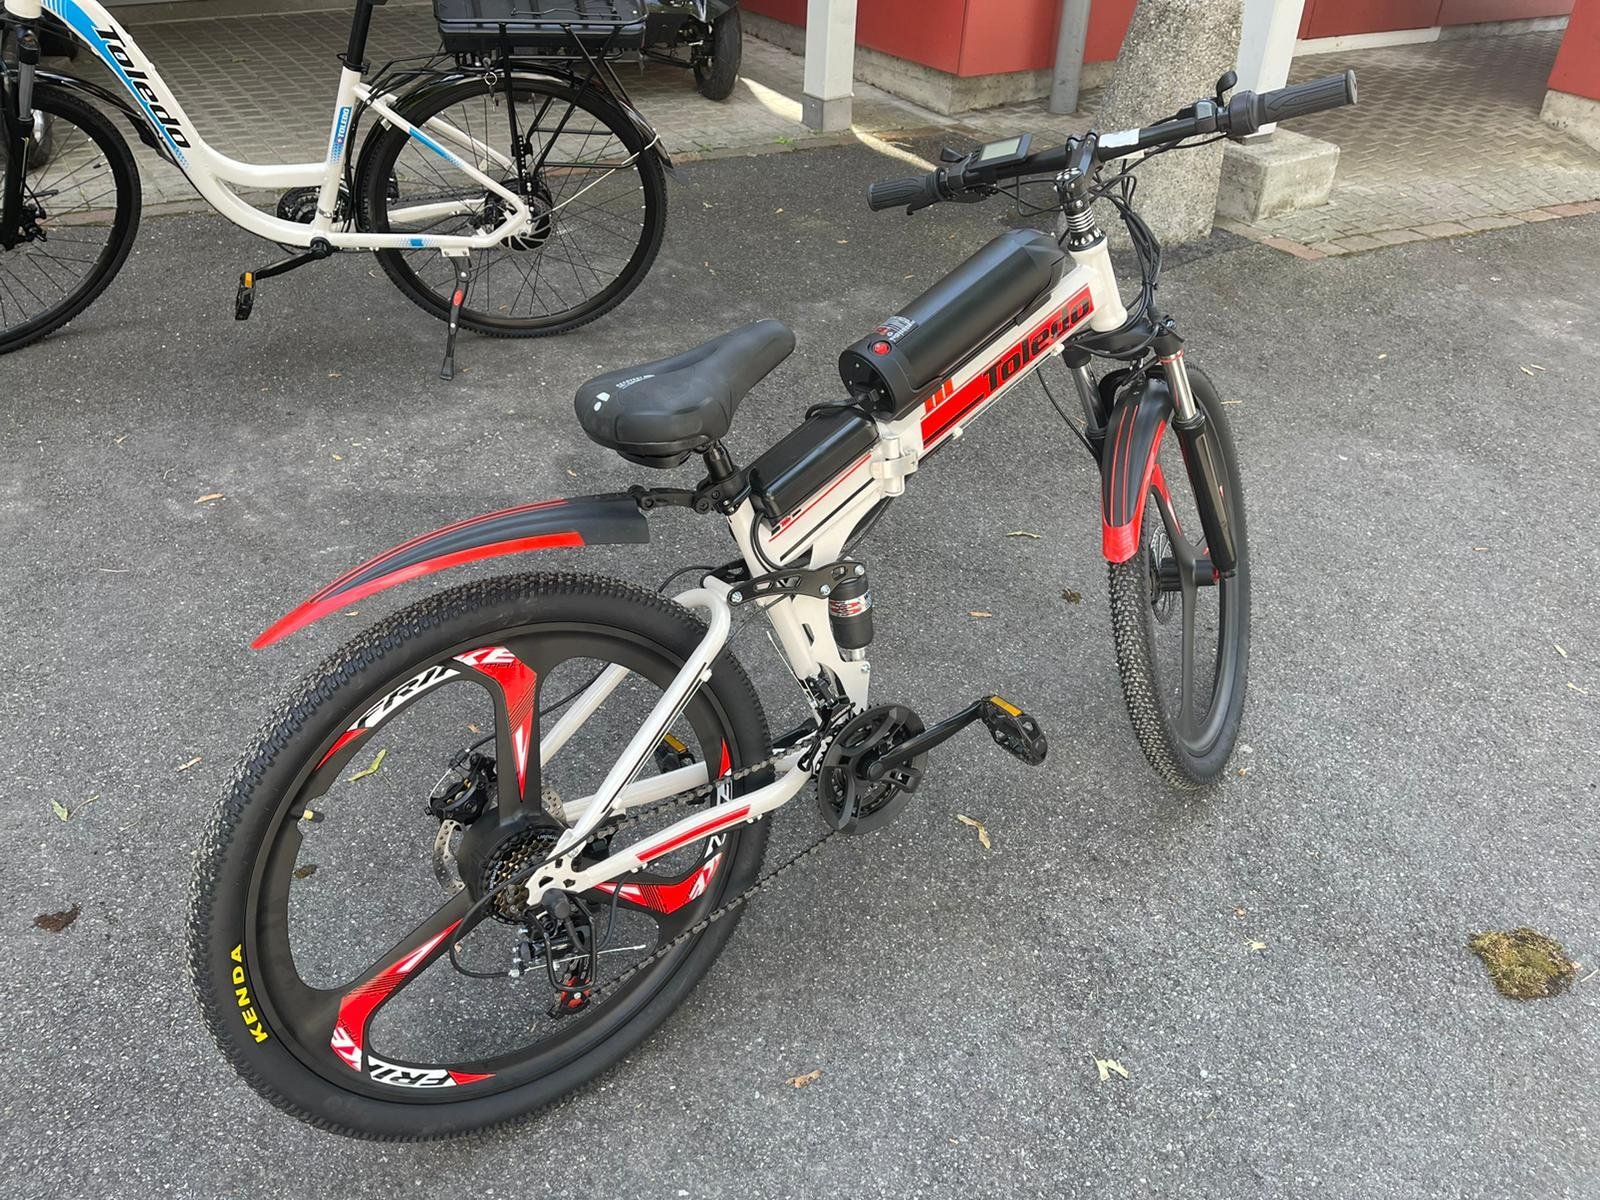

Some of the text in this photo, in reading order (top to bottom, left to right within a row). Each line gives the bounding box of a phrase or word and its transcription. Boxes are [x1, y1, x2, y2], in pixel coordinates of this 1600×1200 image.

[95, 24, 191, 148] Toledo
[337, 107, 350, 138] TOLEDO
[984, 297, 1091, 392] Toledo
[231, 943, 268, 1043] KENDA
